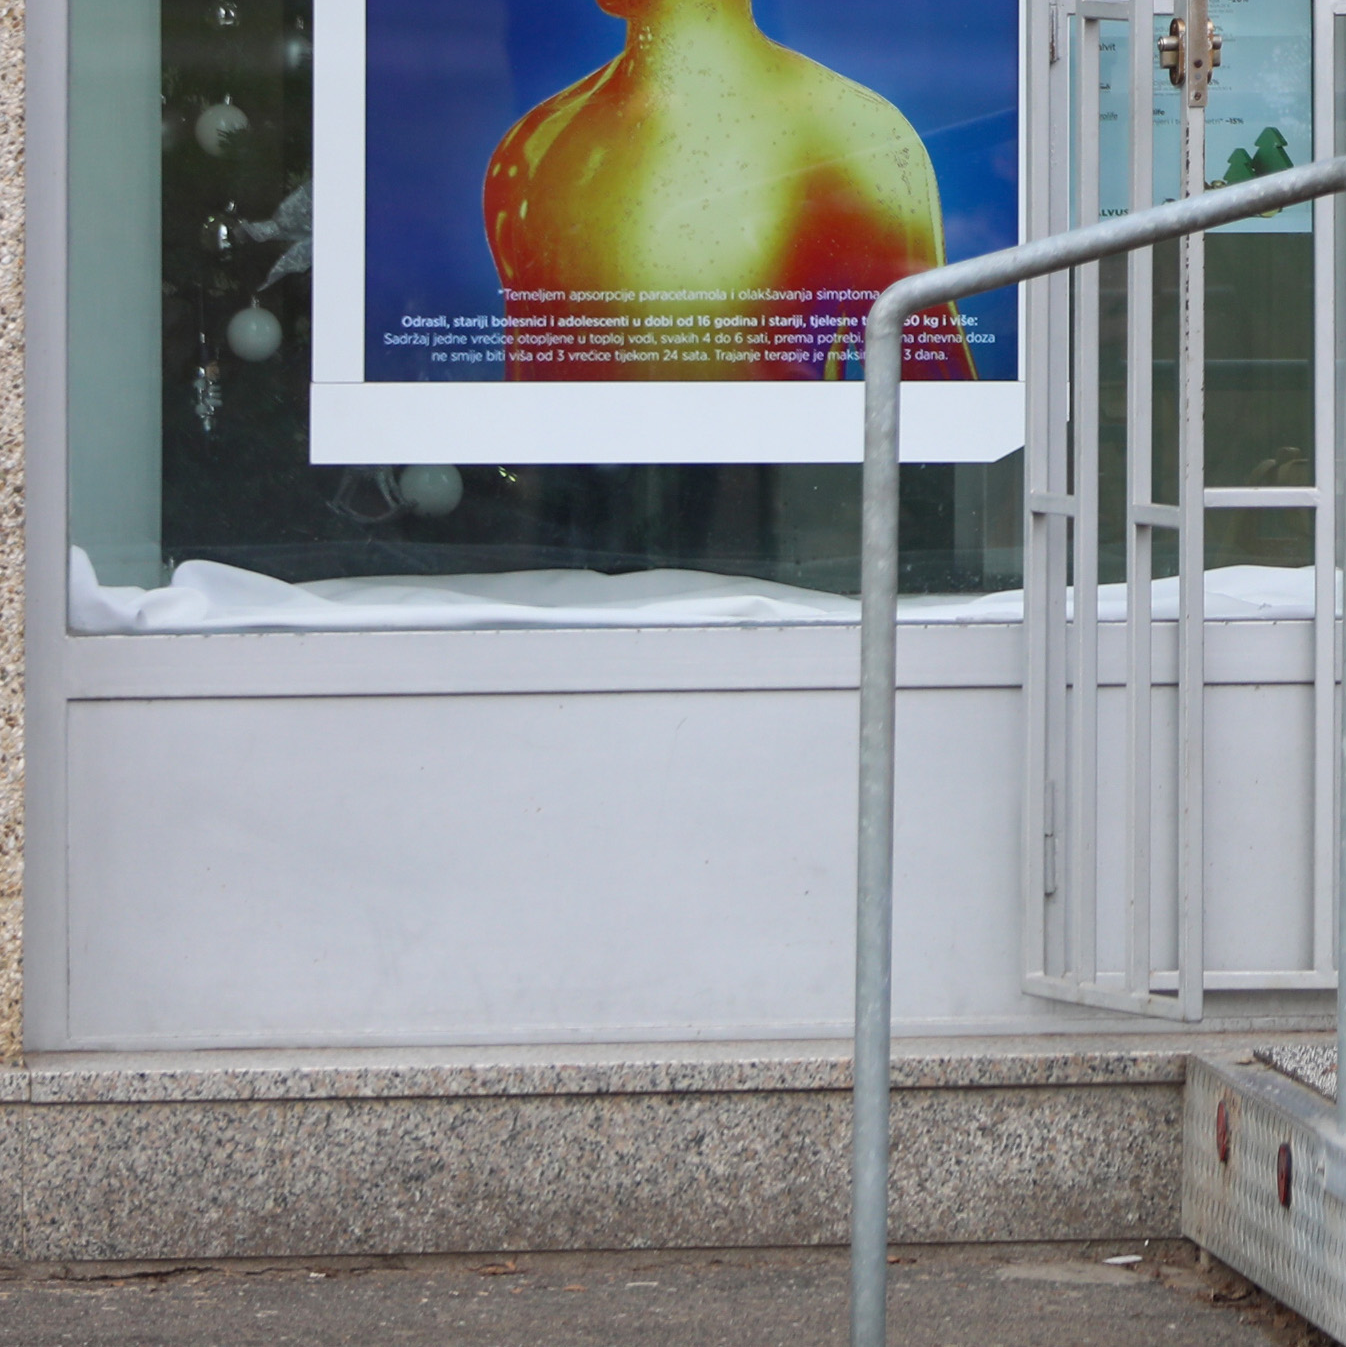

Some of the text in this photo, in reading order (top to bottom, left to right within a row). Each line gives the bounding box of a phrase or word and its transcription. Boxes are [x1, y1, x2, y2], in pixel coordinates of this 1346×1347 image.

[569, 289, 635, 303] apsorpcije
[639, 289, 726, 303] paracetamola
[739, 289, 812, 303] olakšavanja
[402, 315, 450, 329] Odrasli,
[454, 316, 488, 329] stariji
[492, 315, 547, 327] bolesnici
[558, 315, 629, 327] adolescenti
[633, 318, 641, 327] u
[645, 315, 673, 327] dobi
[677, 315, 694, 327] od
[698, 316, 710, 327] 16
[714, 315, 757, 329] godina
[769, 316, 806, 329] stariji,
[810, 315, 858, 329] tjelesne
[924, 315, 938, 329] kg
[950, 314, 978, 326] više:
[383, 333, 430, 347] Sadržaj
[434, 334, 467, 347] jedne
[471, 333, 514, 345] vrećice
[518, 333, 574, 347] otopljene
[578, 335, 586, 345] u
[589, 333, 624, 347] toploj
[628, 333, 657, 346] vodi,
[661, 333, 699, 344] svakih
[702, 333, 710, 344] 4
[715, 332, 730, 344] do
[735, 332, 743, 344] 6
[747, 332, 771, 346] sati,
[775, 334, 814, 346] prema
[818, 332, 864, 346] potrebi.
[918, 332, 963, 344] dnevna
[967, 332, 995, 344] doza
[432, 349, 948, 364] ne smije biti viša od 3 vrećice tijekom 24 sata. Trajanje terapije je 3 dana.
